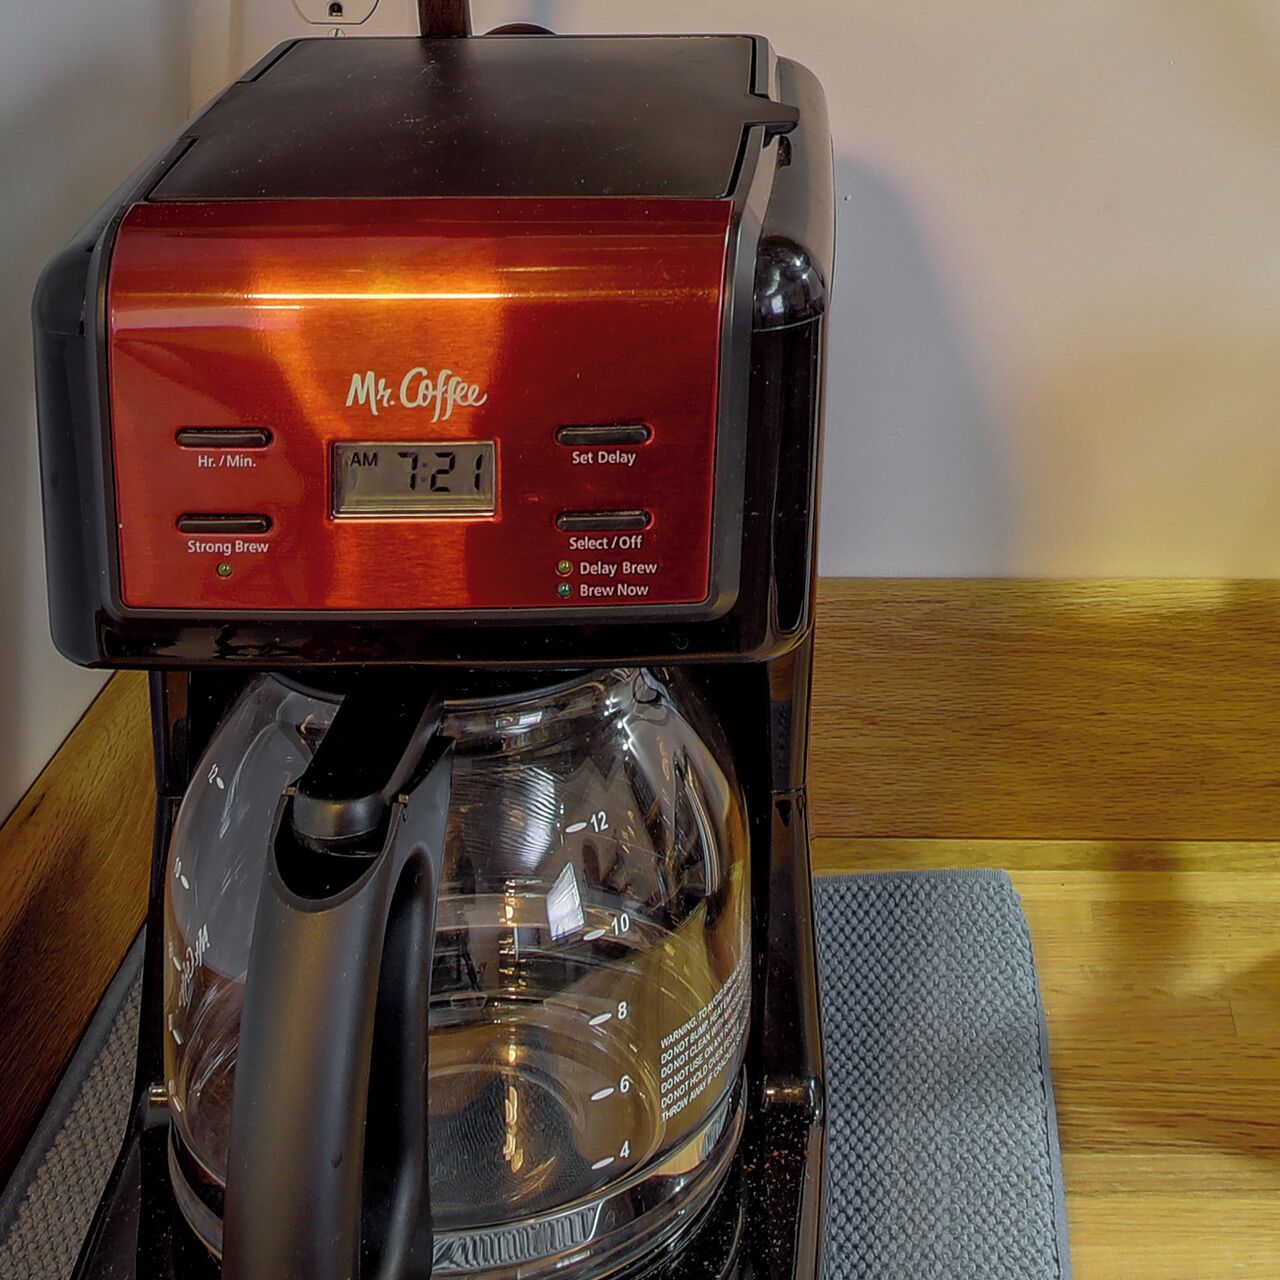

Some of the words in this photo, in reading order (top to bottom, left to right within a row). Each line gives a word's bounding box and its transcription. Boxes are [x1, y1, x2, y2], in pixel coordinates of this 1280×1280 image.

[345, 371, 396, 416] Mr.
[399, 367, 488, 423] Coffee
[197, 455, 216, 468] Hr.
[226, 454, 257, 468] Min.
[572, 451, 594, 465] Set
[598, 450, 637, 466] Delay
[350, 452, 378, 467] AM
[397, 452, 483, 493] 7:21
[187, 540, 232, 556] Strong
[235, 540, 269, 553] Brew
[569, 536, 609, 550] Select
[619, 535, 643, 549] Off
[580, 561, 618, 577] Delay
[622, 561, 658, 574] Brew
[580, 584, 615, 597] Brew
[617, 583, 649, 596] Now
[590, 811, 609, 832] 12
[611, 912, 629, 936] 10
[617, 1001, 627, 1019] 8
[661, 1049, 673, 1065] DO
[674, 1036, 689, 1056] NOT
[661, 1063, 673, 1078] DO
[674, 1050, 689, 1070] NOT
[690, 1031, 711, 1057] CLEAN
[661, 1078, 673, 1094] DO
[674, 1065, 689, 1085] NOT
[690, 1053, 705, 1072] USE
[619, 1074, 630, 1094] 6
[661, 1093, 673, 1109] DO
[674, 1080, 689, 1100] NOT
[690, 1064, 708, 1088] HOLD
[662, 1095, 689, 1122] THROW
[620, 1140, 630, 1160] 4
